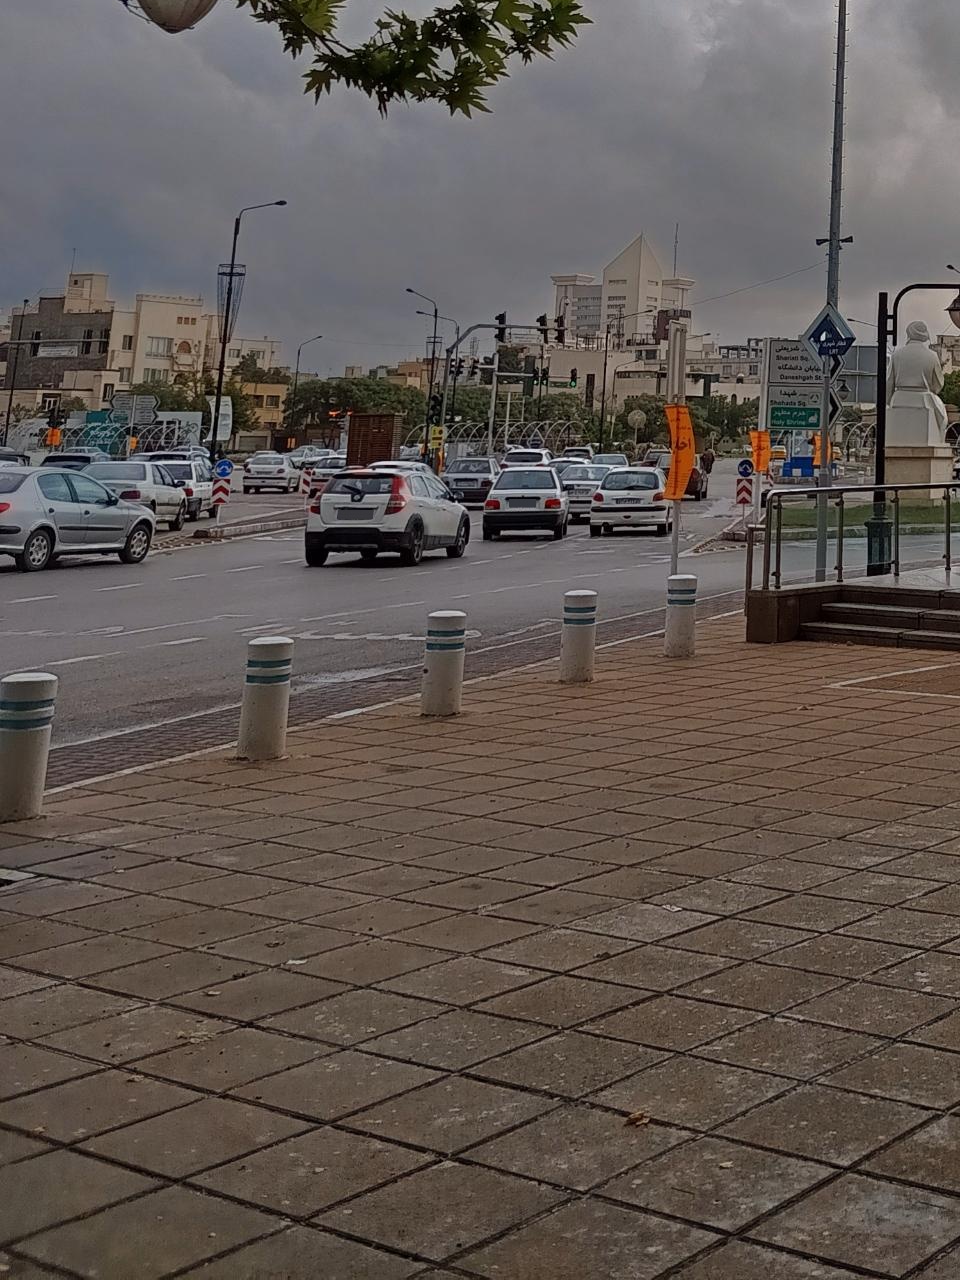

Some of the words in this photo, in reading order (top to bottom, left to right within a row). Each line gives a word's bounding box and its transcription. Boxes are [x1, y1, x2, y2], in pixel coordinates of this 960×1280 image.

[775, 345, 800, 353] شریعتی
[777, 364, 803, 372] دانشگاه
[779, 389, 797, 397] شهدا
